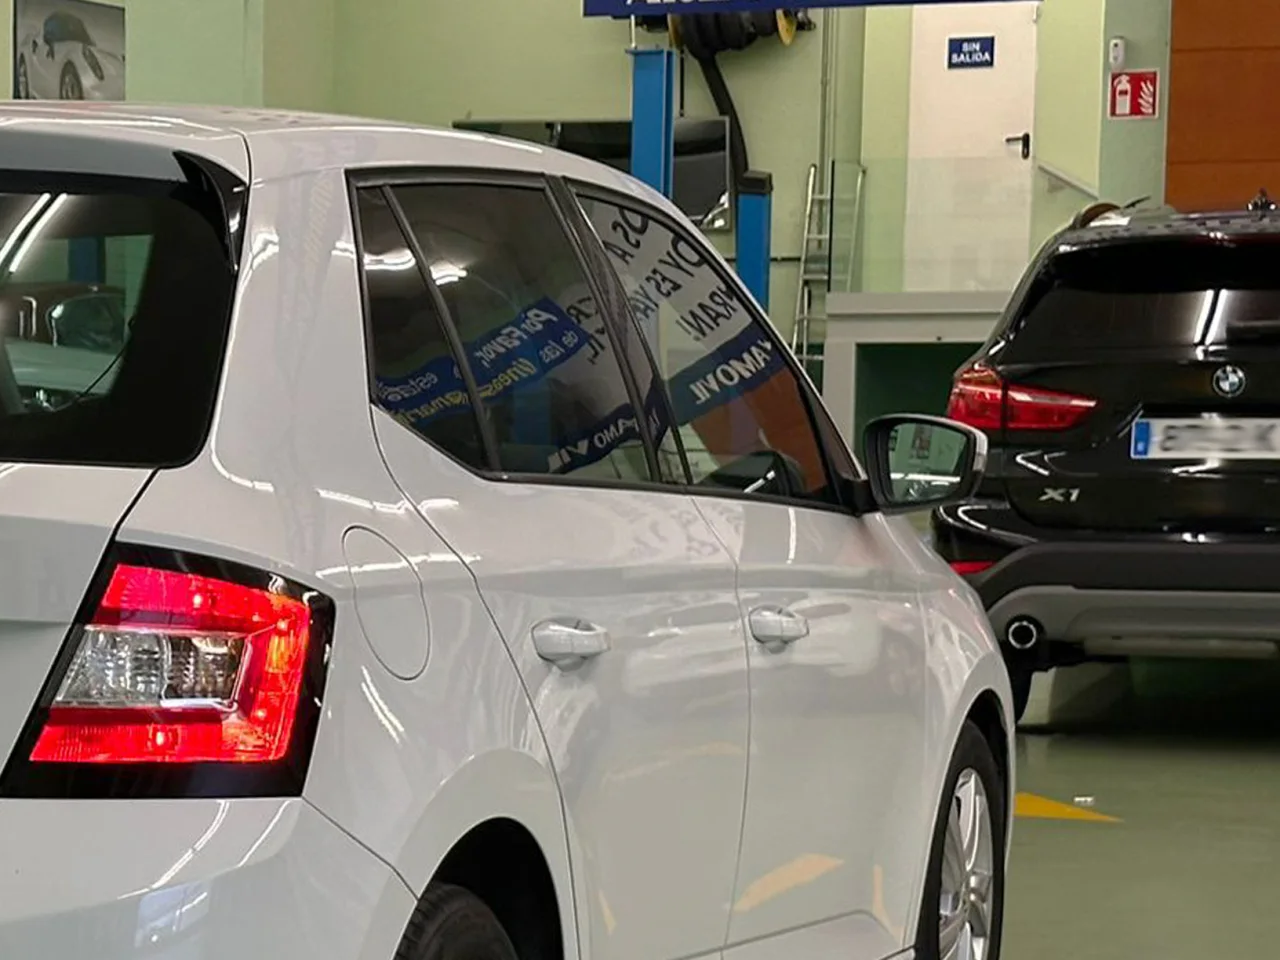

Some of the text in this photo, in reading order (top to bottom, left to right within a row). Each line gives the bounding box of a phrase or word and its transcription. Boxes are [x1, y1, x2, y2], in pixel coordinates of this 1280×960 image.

[961, 42, 980, 52] SIN
[951, 51, 991, 63] SALIDA
[1040, 487, 1081, 502] X1
